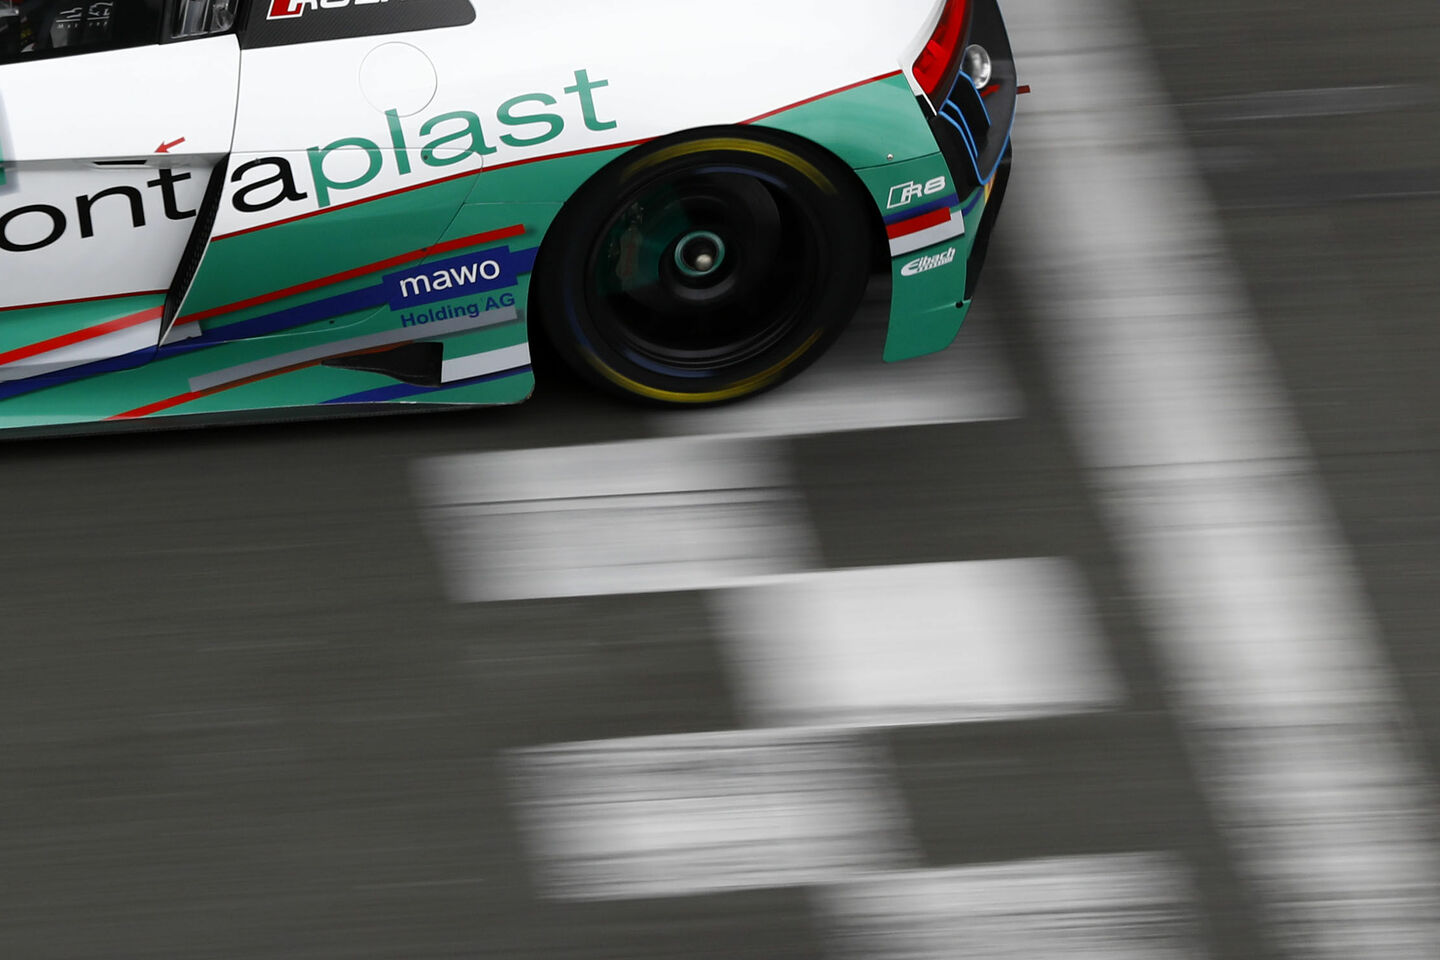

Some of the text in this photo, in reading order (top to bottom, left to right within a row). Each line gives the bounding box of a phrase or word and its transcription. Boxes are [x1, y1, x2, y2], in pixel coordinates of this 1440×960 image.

[900, 176, 946, 203] R8
[400, 260, 500, 298] mawo
[401, 293, 515, 327] Holding AG
